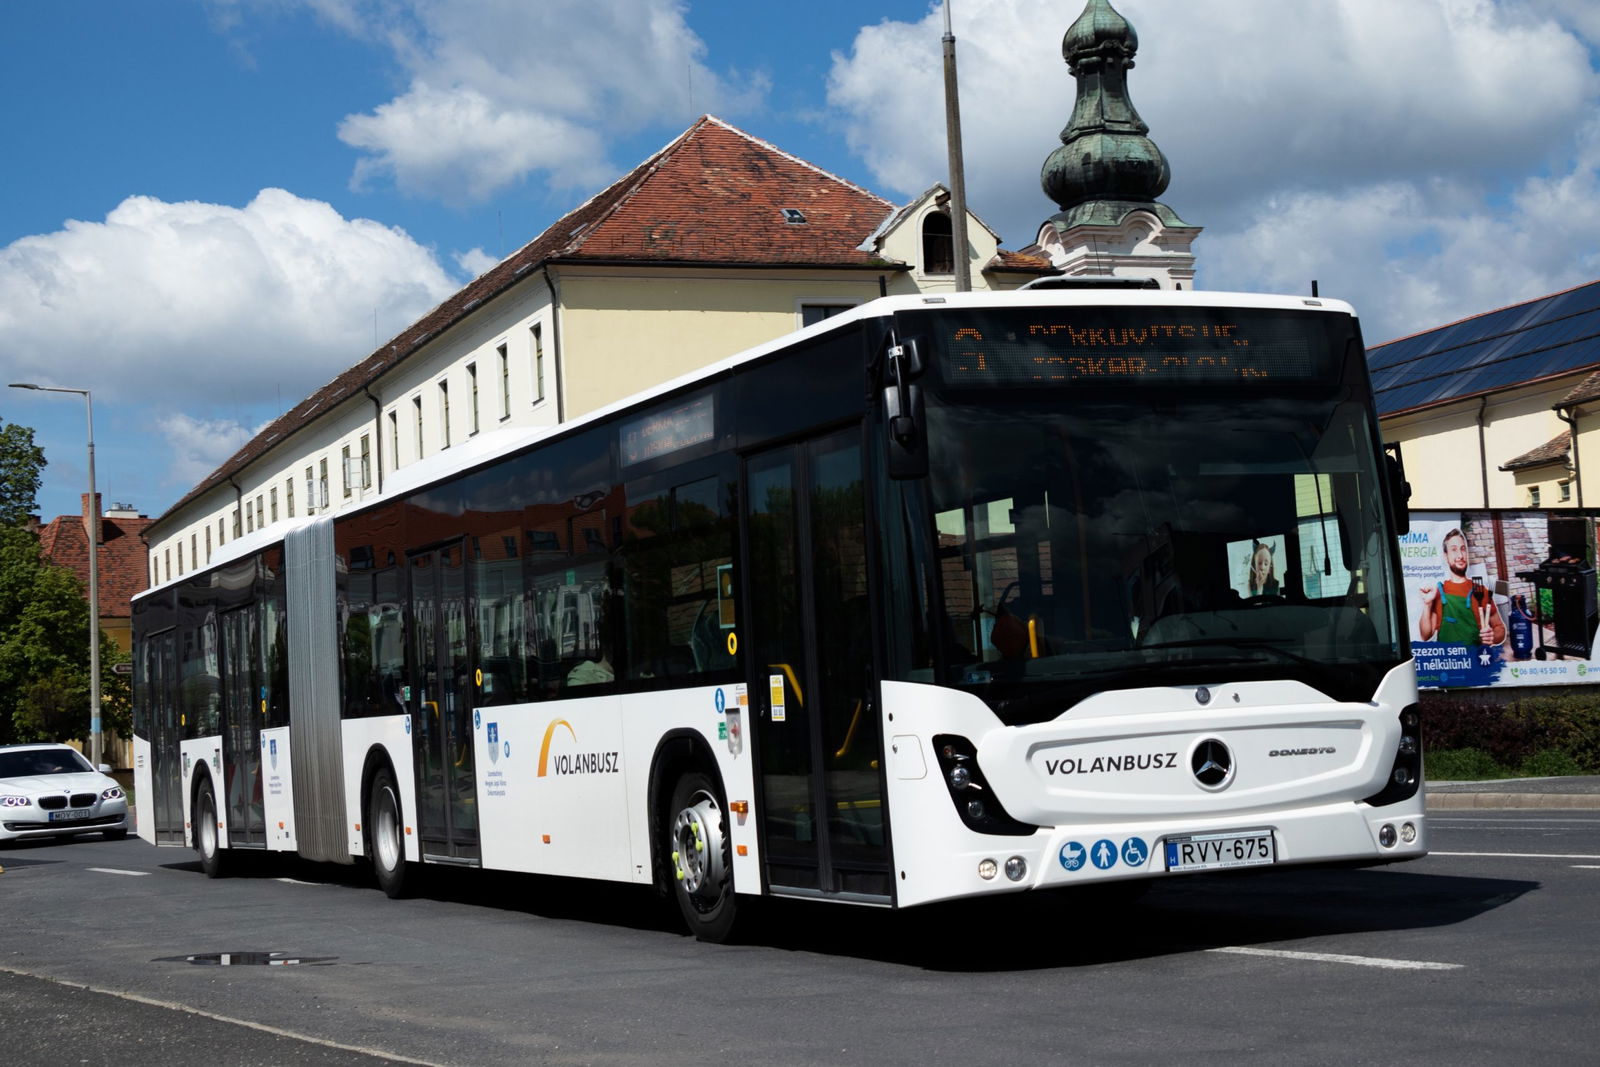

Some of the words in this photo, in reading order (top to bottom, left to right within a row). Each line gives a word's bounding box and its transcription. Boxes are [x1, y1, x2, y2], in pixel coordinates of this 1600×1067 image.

[1400, 546, 1438, 558] NERGIA
[1447, 646, 1467, 656] sem
[1423, 657, 1472, 671] nélkülünk!
[554, 751, 619, 776] VOLÁNBUSZ
[1046, 752, 1178, 776] VOLÁNBUSZ
[1181, 838, 1269, 864] RVY-675
[1169, 856, 1176, 864] H
